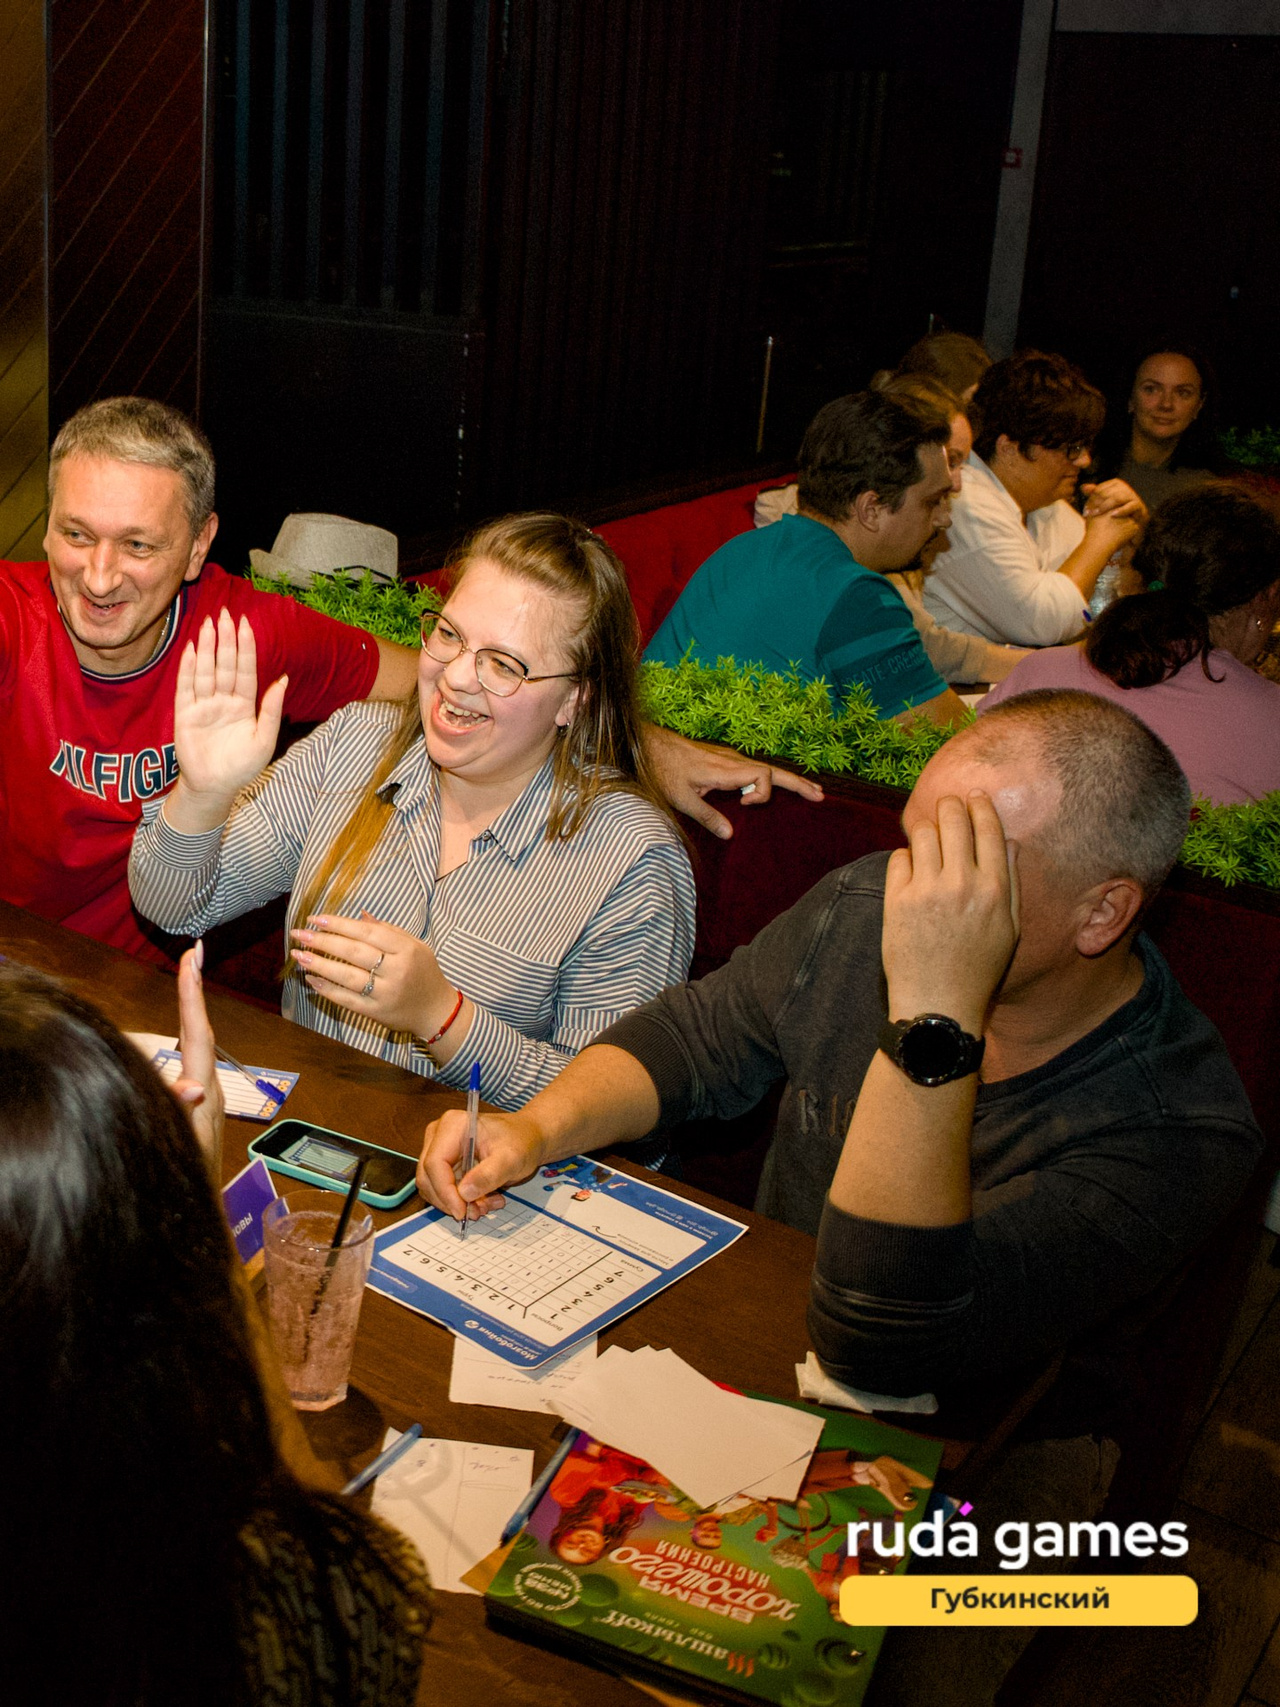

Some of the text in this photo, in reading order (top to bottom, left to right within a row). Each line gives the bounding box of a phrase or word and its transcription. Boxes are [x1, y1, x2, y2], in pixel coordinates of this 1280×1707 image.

[471, 1283, 482, 1291] 3
[561, 1305, 572, 1313] 2
[478, 1325, 538, 1360] Мозгобойня
[654, 1539, 771, 1589] НАСТРОЕНИЯ
[638, 1576, 756, 1624] ВРЕМЯ
